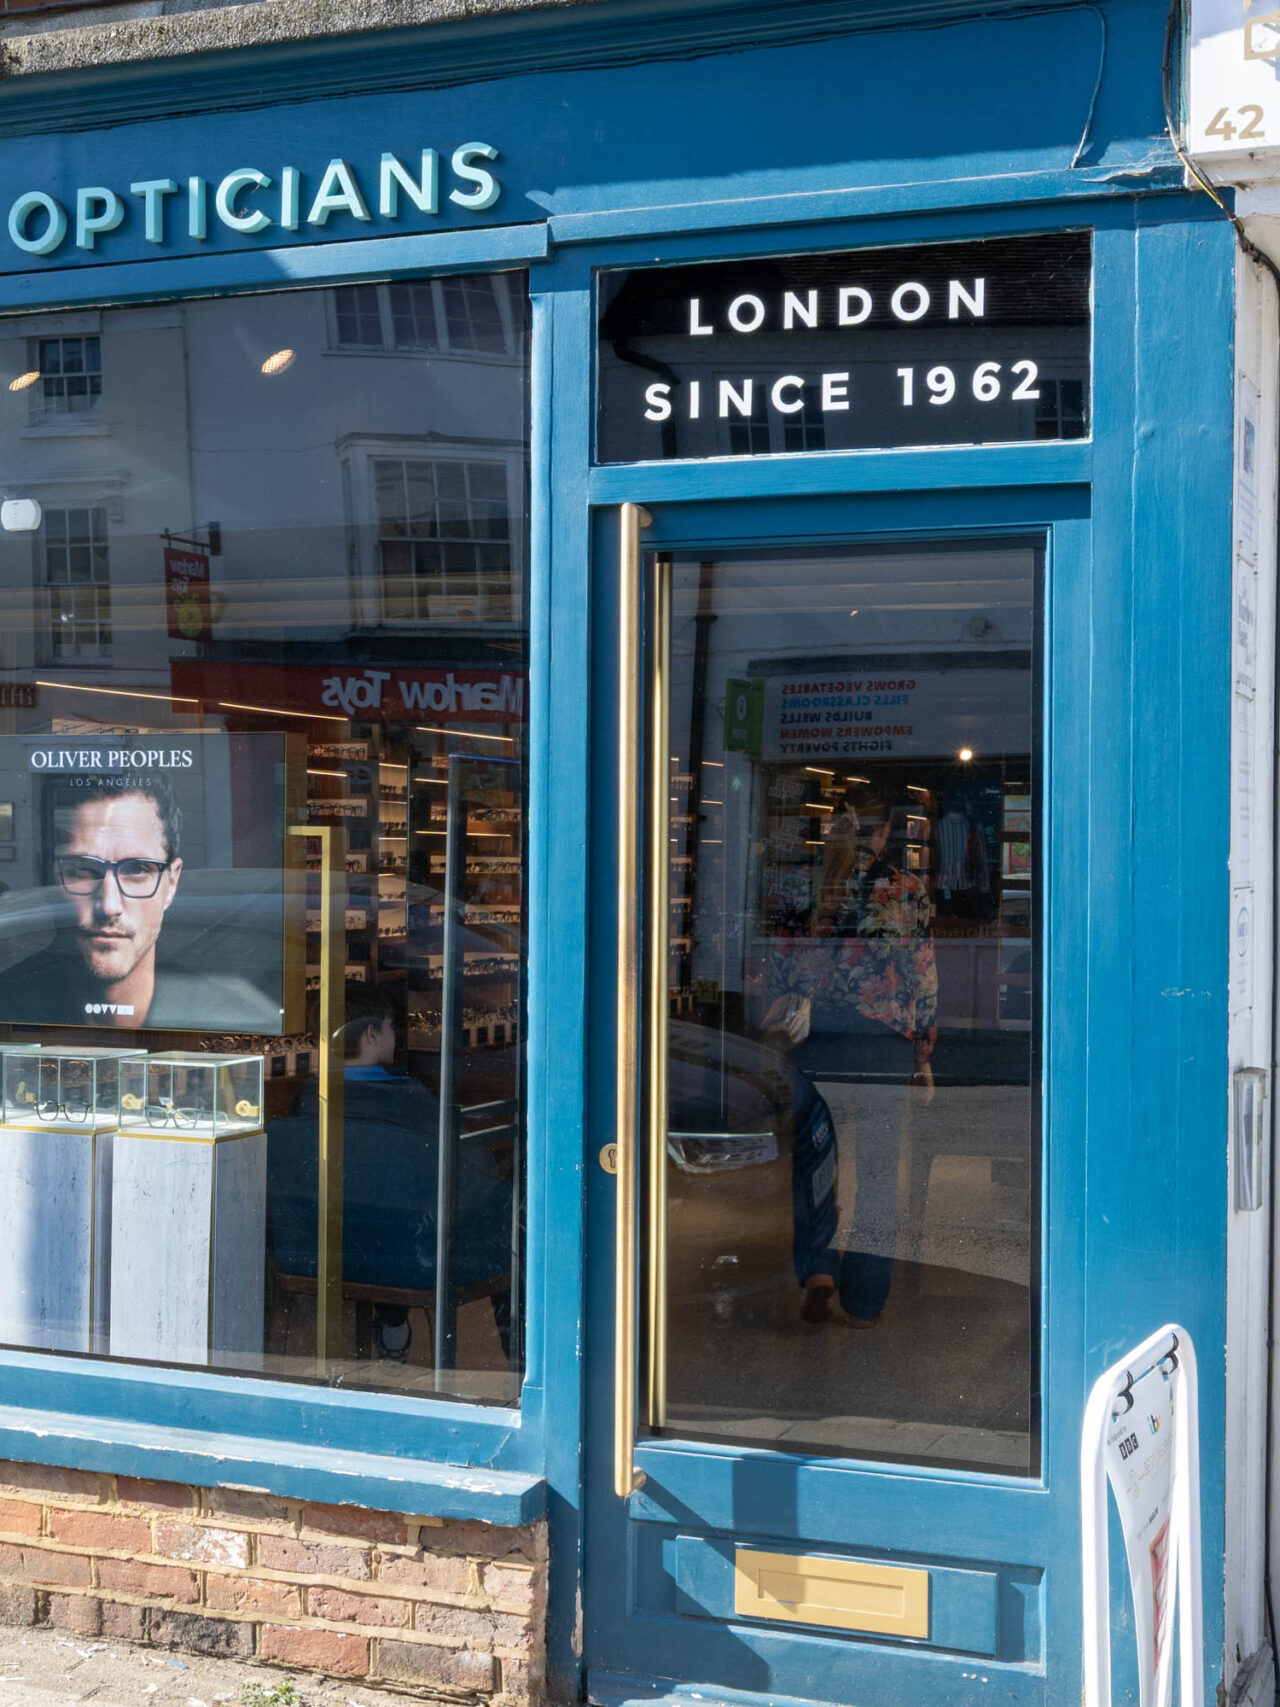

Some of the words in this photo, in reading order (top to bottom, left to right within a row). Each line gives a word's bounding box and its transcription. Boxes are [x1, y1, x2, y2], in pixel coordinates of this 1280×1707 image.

[1205, 104, 1265, 141] 42
[8, 141, 502, 255] OPTICIANS
[689, 277, 987, 336] LONDON
[643, 371, 851, 422] SINCE
[896, 360, 1041, 407] 1962
[31, 750, 102, 768] OLIVER
[108, 750, 193, 768] PEOPLES
[70, 778, 91, 787] LOS
[98, 777, 152, 787] ANGELES
